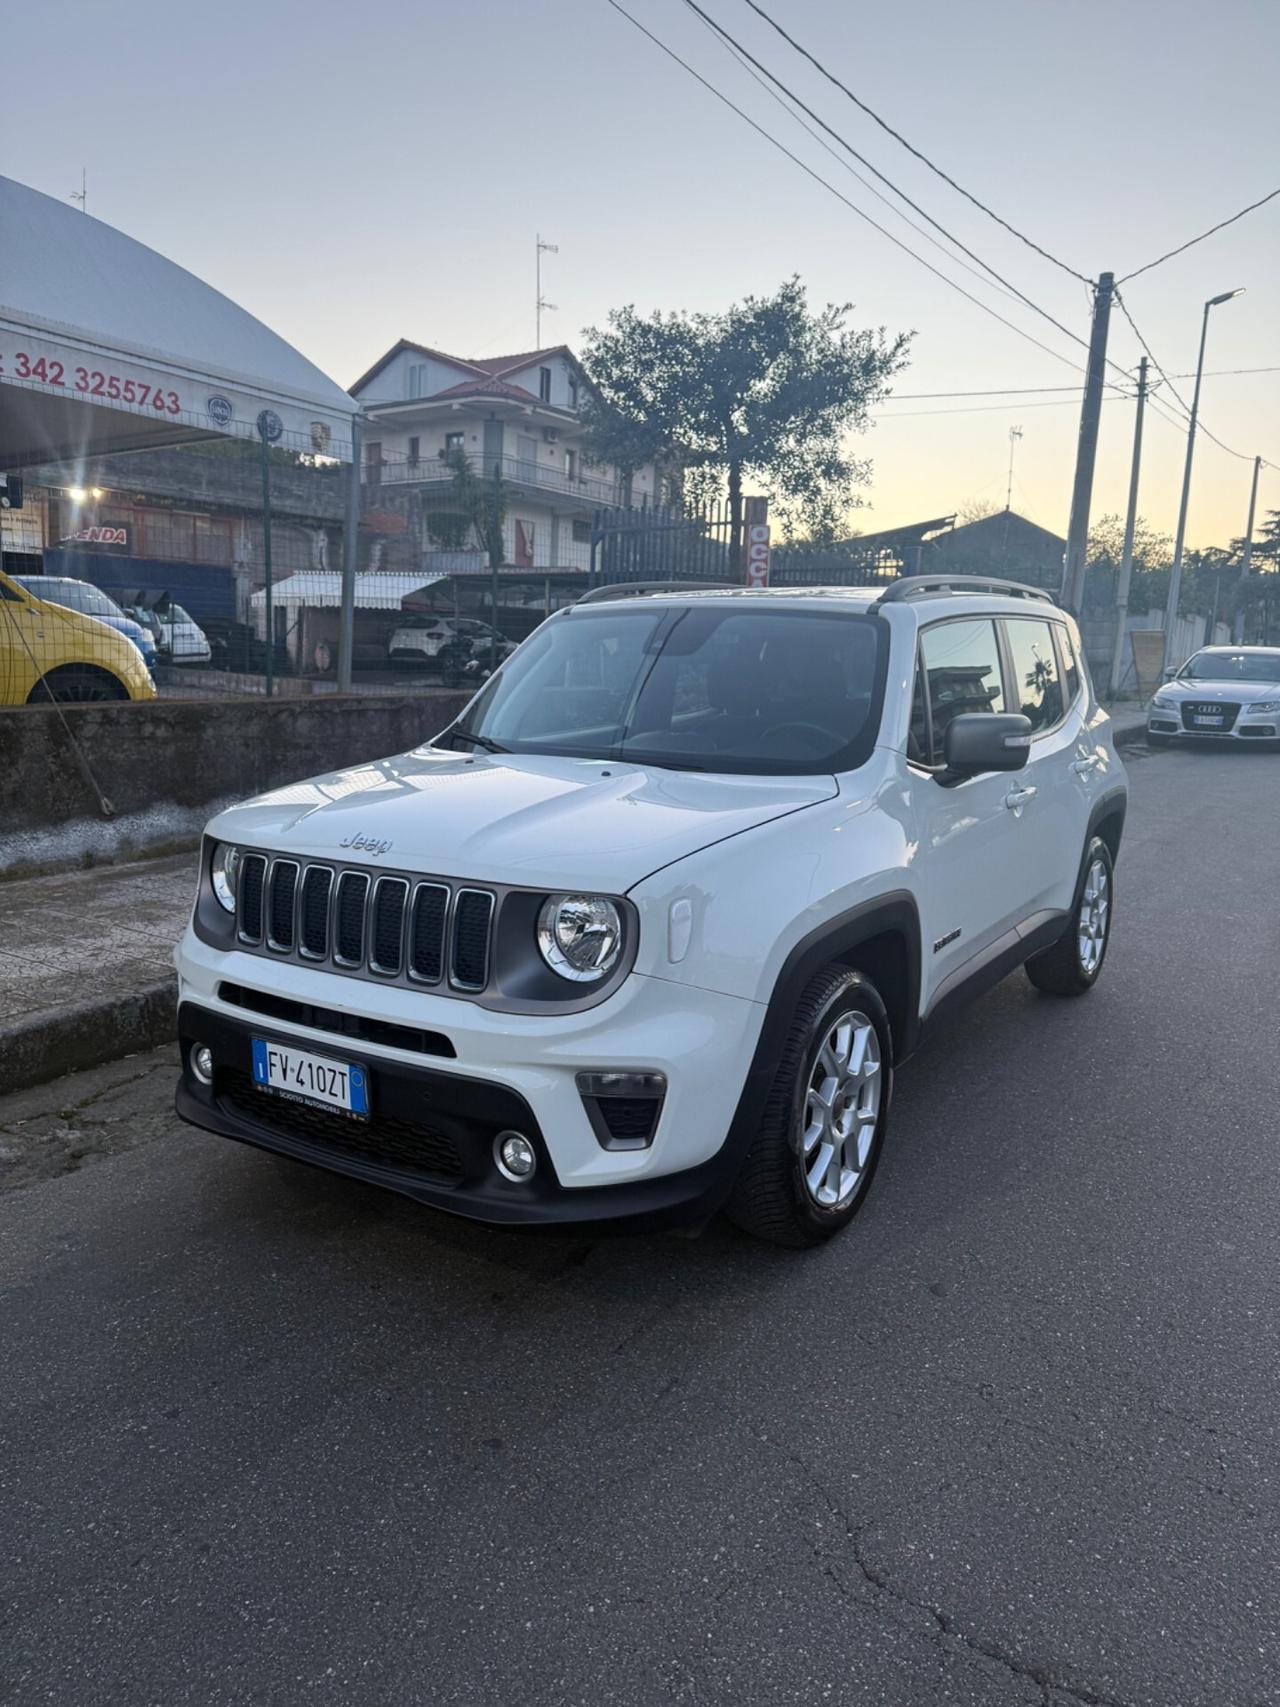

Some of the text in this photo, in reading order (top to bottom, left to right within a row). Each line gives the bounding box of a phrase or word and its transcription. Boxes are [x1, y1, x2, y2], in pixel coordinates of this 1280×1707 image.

[15, 352, 65, 386] 342
[75, 367, 180, 414] 3255763
[339, 831, 393, 857] Jeep
